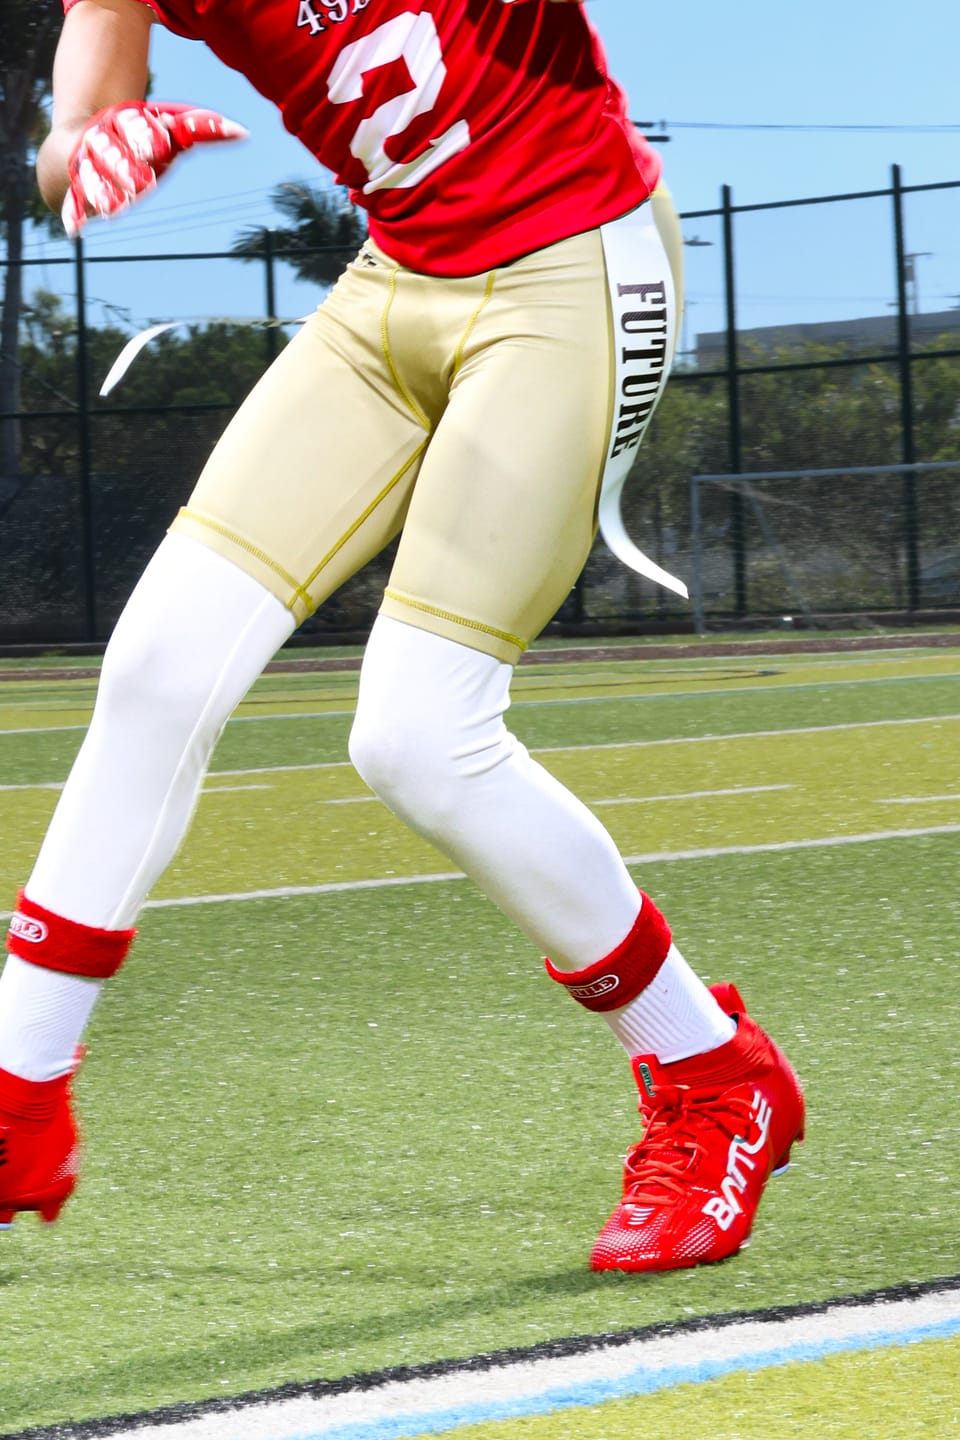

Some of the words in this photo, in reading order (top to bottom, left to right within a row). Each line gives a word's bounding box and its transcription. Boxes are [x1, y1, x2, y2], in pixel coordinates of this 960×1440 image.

[326, 11, 472, 194] 2
[610, 280, 667, 459] FUTURE
[702, 1091, 773, 1231] BATTLE
